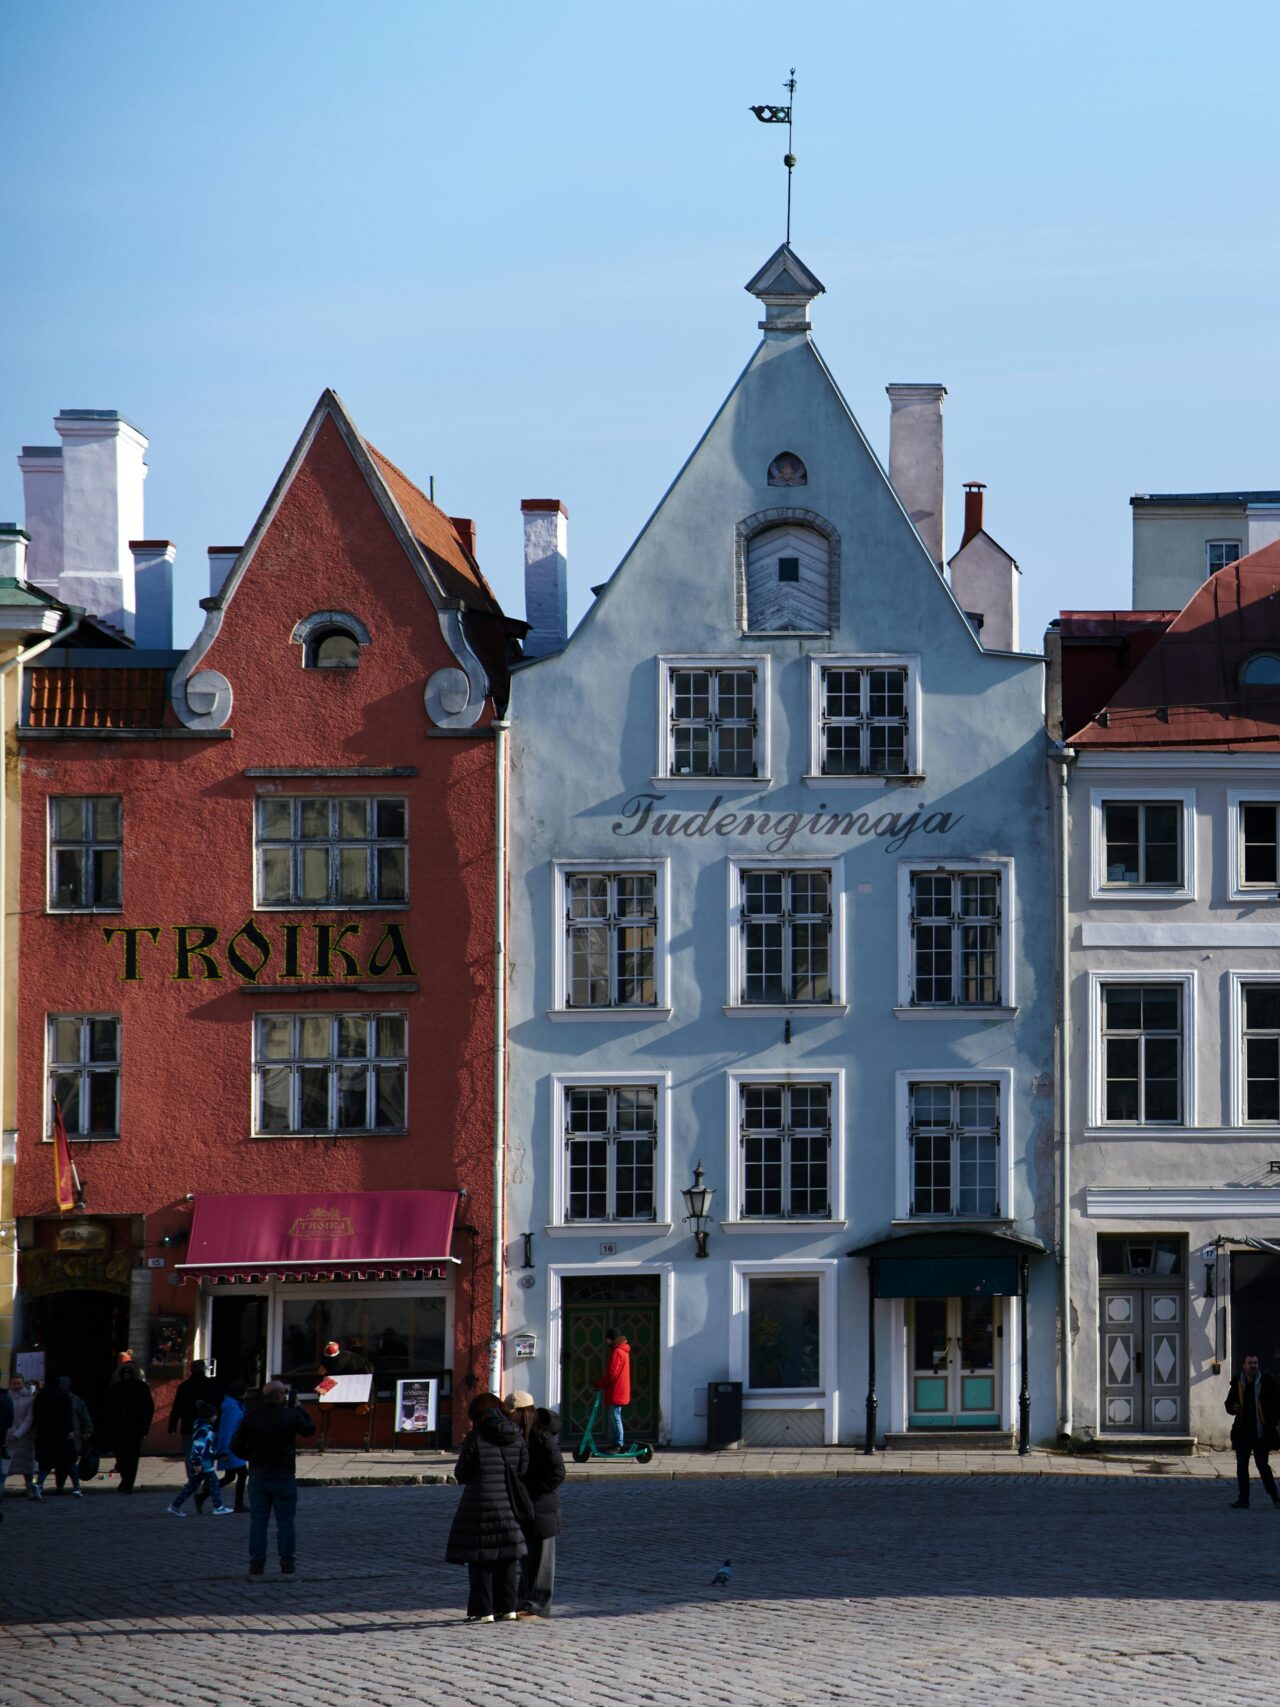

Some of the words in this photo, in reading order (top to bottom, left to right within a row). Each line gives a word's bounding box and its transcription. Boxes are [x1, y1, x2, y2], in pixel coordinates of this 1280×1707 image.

[611, 793, 965, 854] Tudengimaja
[102, 916, 418, 983] TROIKA
[603, 1245, 613, 1253] 16
